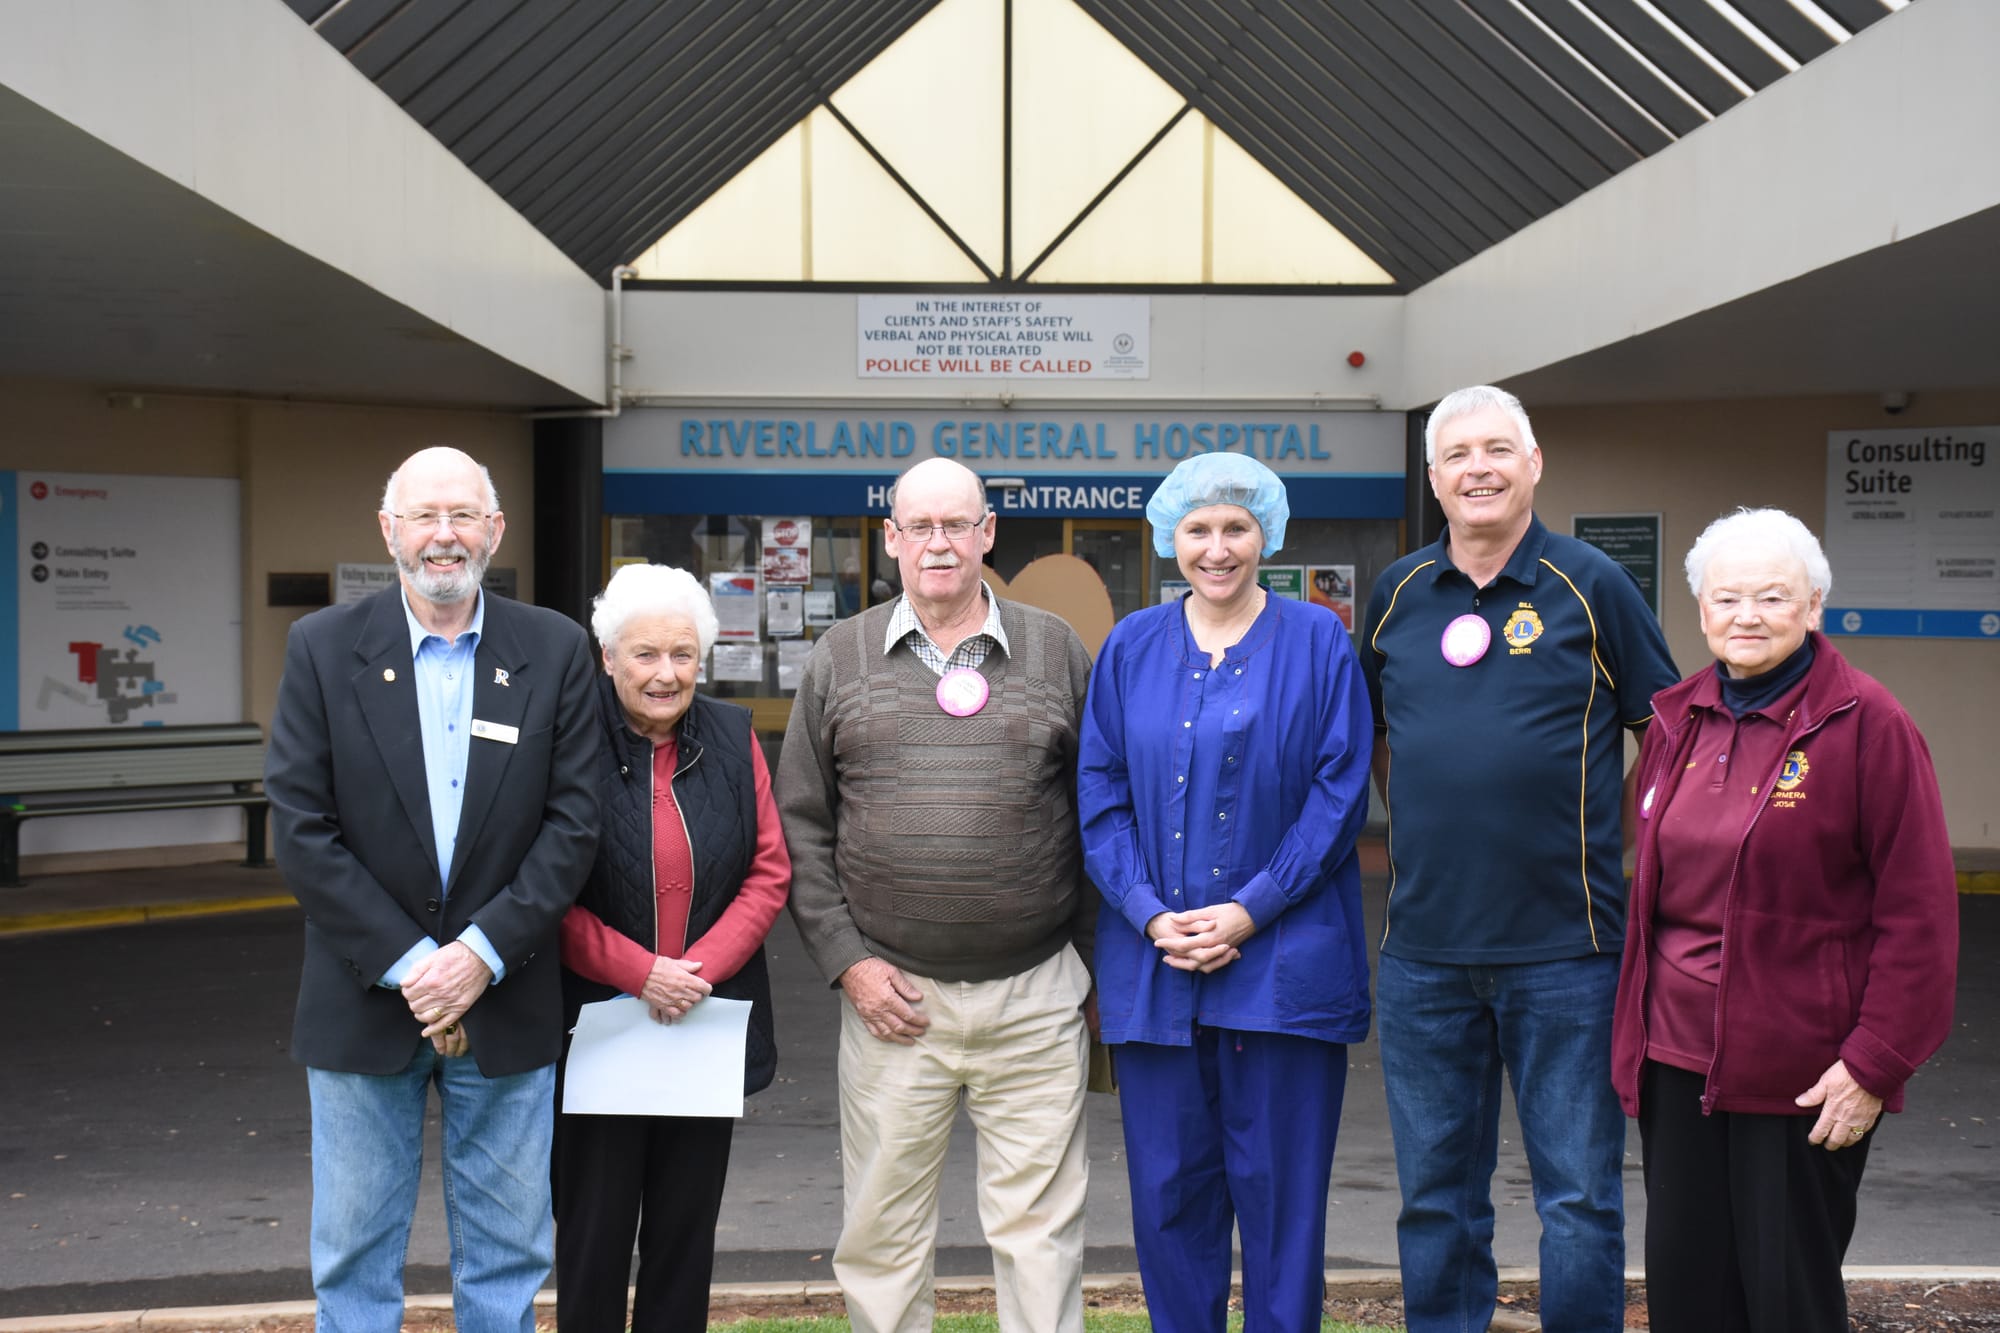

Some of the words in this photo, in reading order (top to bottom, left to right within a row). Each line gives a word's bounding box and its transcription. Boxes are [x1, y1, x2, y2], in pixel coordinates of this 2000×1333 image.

[916, 302, 930, 312] IN
[934, 302, 958, 312] THE
[961, 302, 1021, 313] INTEREST
[1025, 302, 1042, 312] OF
[885, 316, 936, 327] CLIENTS
[939, 316, 968, 327] AND
[972, 316, 1021, 328] STAFF'S
[1025, 316, 1073, 328] SAFETY
[865, 330, 914, 341] VERBAL
[918, 330, 947, 341] AND
[950, 330, 1013, 342] PHYSICAL
[1017, 331, 1059, 342] ABUSE
[1063, 331, 1094, 342] WILL
[916, 345, 944, 356] NOT
[948, 345, 963, 356] BE
[967, 345, 1042, 356] TOLERATED
[866, 359, 931, 372] POLICE
[938, 359, 984, 373] WILL
[990, 359, 1013, 373] BE
[1019, 359, 1092, 374] CALLED
[680, 419, 916, 457] RIVERLAND
[933, 420, 1118, 459] GENERAL
[1134, 422, 1332, 460] HOSPITAL
[1846, 436, 1986, 467] Consulting
[1845, 469, 1913, 494] Suite
[55, 485, 109, 500] Emergency
[1003, 487, 1143, 509] ENTRANCE
[55, 546, 108, 560] Consulting
[110, 547, 136, 558] Suite
[55, 568, 79, 578] Main
[82, 568, 109, 580] Entry
[1518, 622, 1528, 636] L
[1783, 763, 1794, 776] L
[1771, 791, 1806, 799] ARMERA
